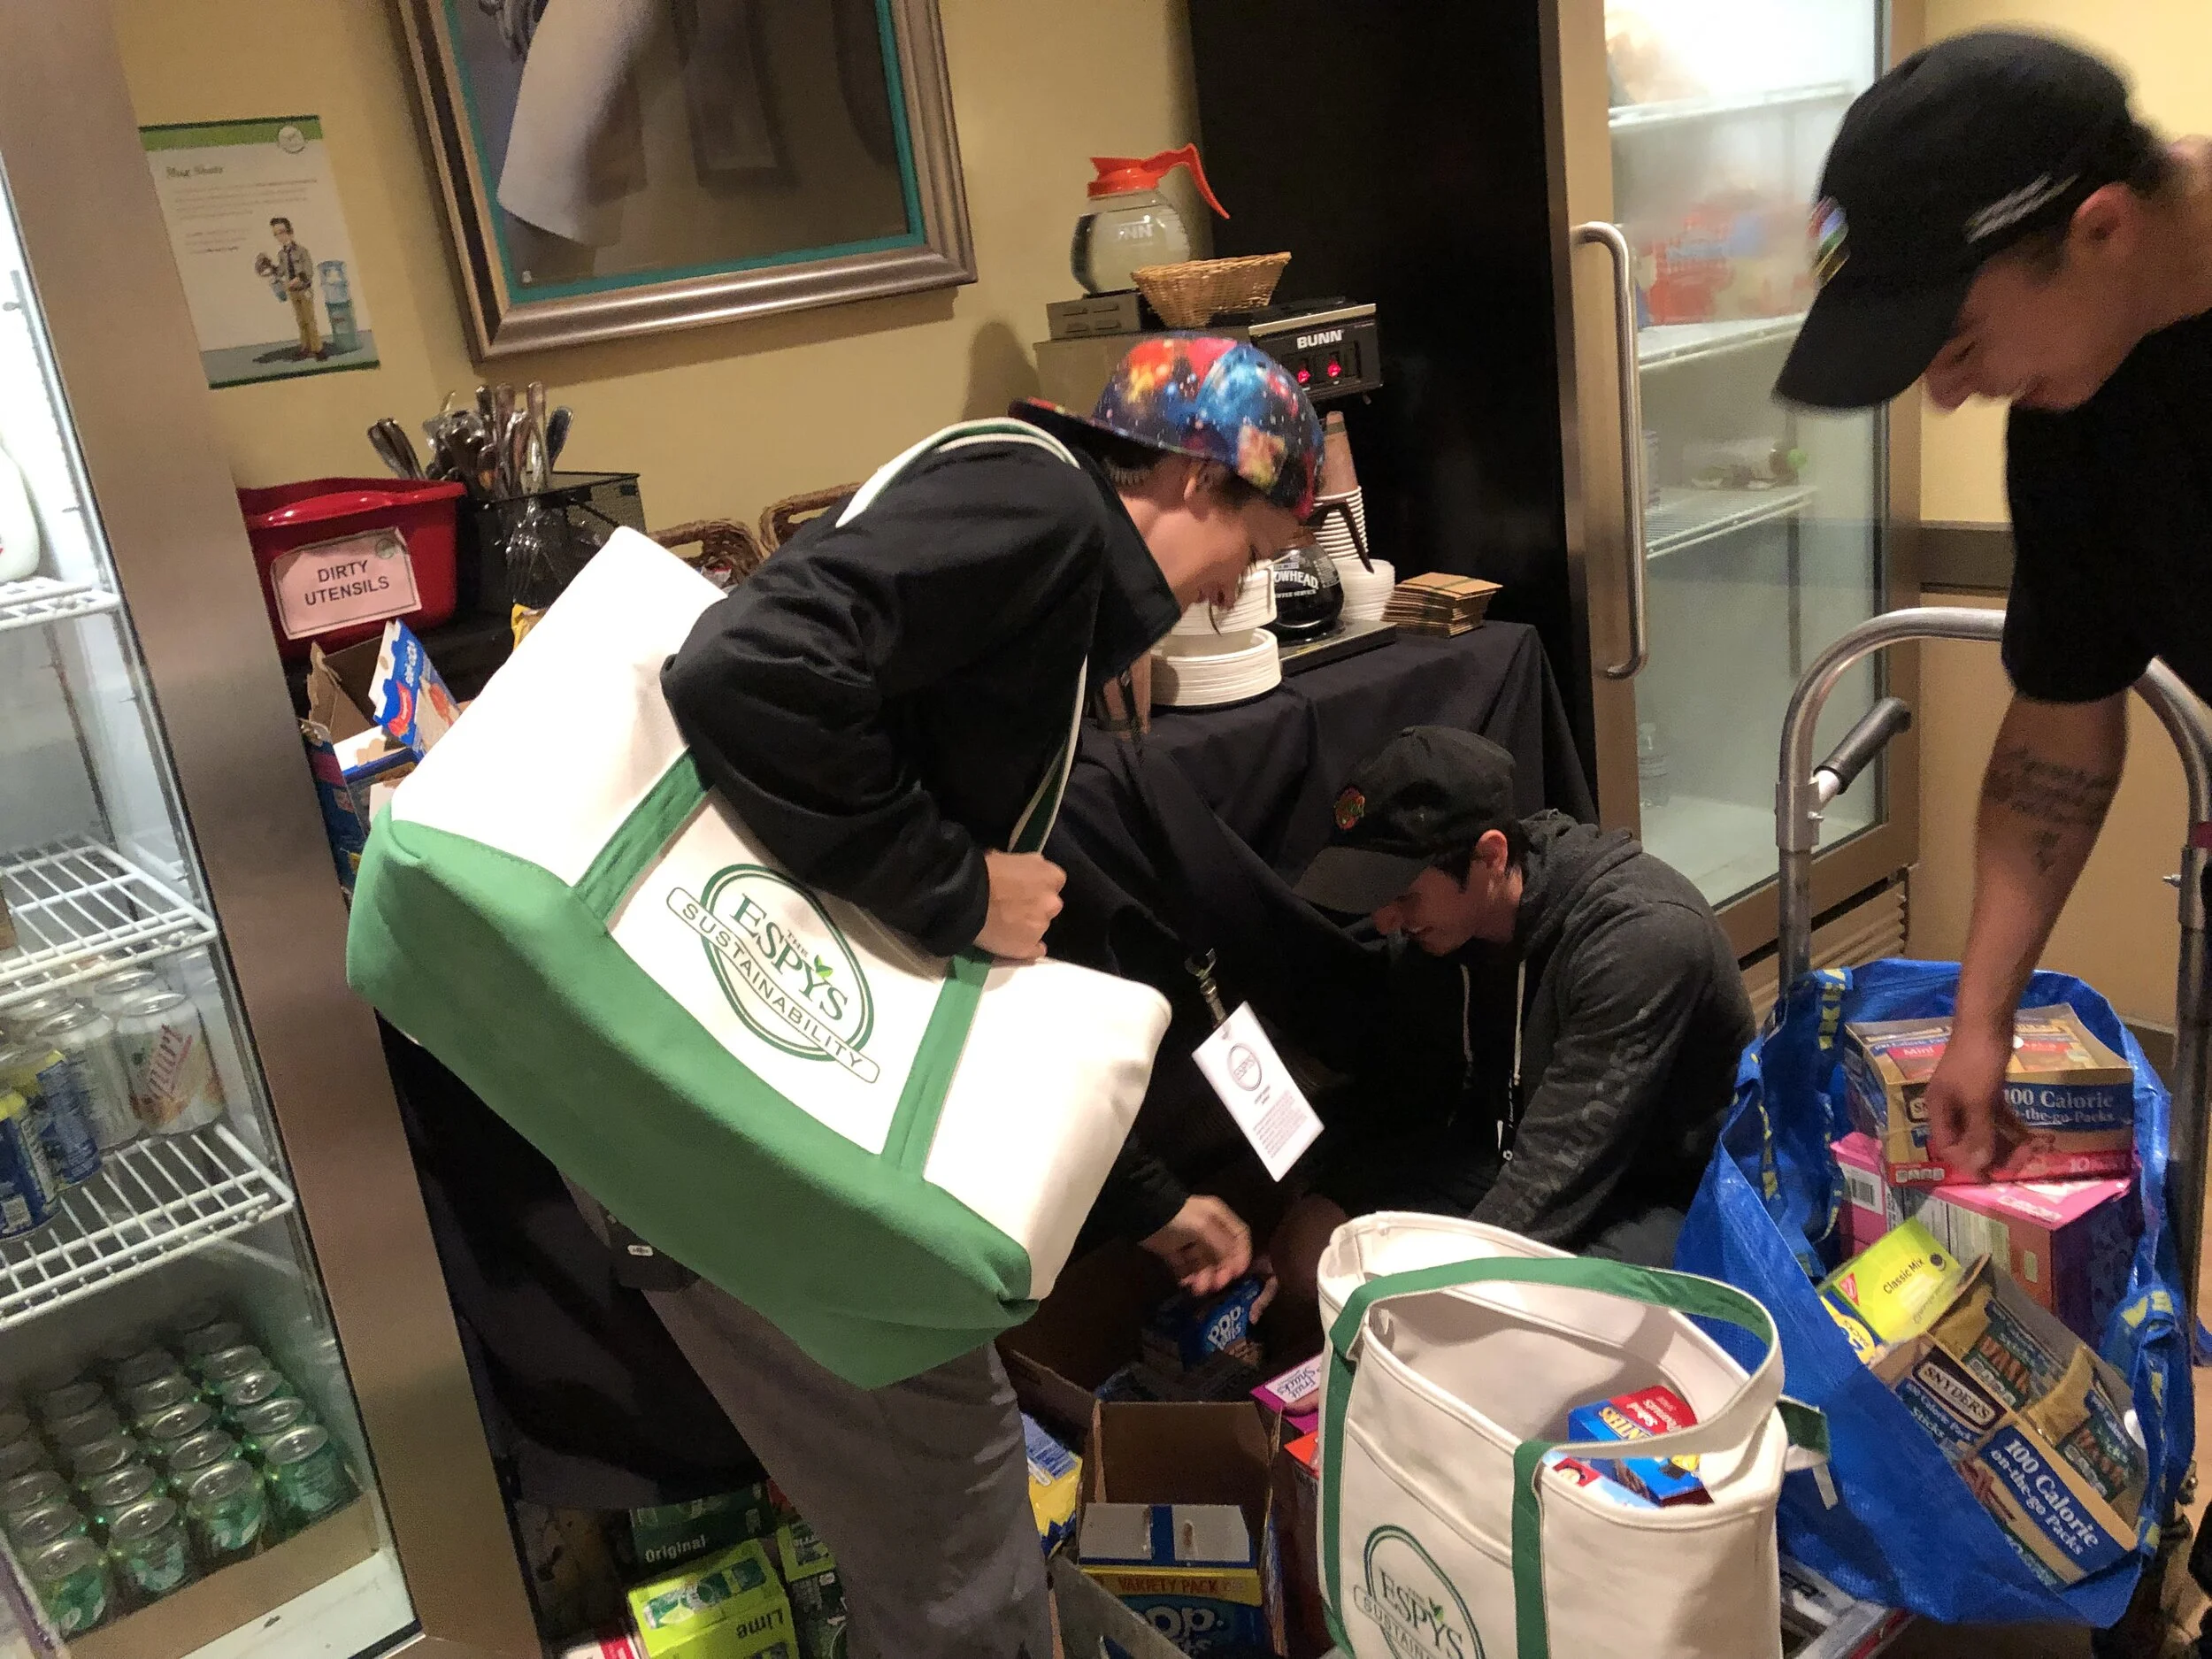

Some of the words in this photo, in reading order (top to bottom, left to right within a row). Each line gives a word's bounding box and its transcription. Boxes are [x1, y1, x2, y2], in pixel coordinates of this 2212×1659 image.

[1296, 329, 1343, 349] BUNN
[317, 559, 369, 583] DIRTY
[1274, 570, 1318, 589] OWHEAD
[304, 576, 390, 606] UTENSILS
[730, 893, 849, 1021] ESPYS
[786, 930, 810, 958] THE
[682, 902, 863, 1068] SUSTAINABILITY
[2040, 1089, 2114, 1108] Calorie
[1883, 1268, 1912, 1295] Classic
[1909, 1256, 1925, 1274] Mix
[1277, 1365, 1316, 1395] Snacks
[1290, 1376, 1316, 1399] Fruit
[1991, 1448, 2047, 1517] on-the-go
[2046, 1514, 2084, 1556] Packs
[2004, 1439, 2040, 1474] 100
[2035, 1473, 2099, 1548] Calorie
[644, 1534, 707, 1563] Original
[1120, 1577, 1179, 1593] VARIETY
[1182, 1578, 1218, 1594] PACK
[735, 1608, 785, 1639] Lime
